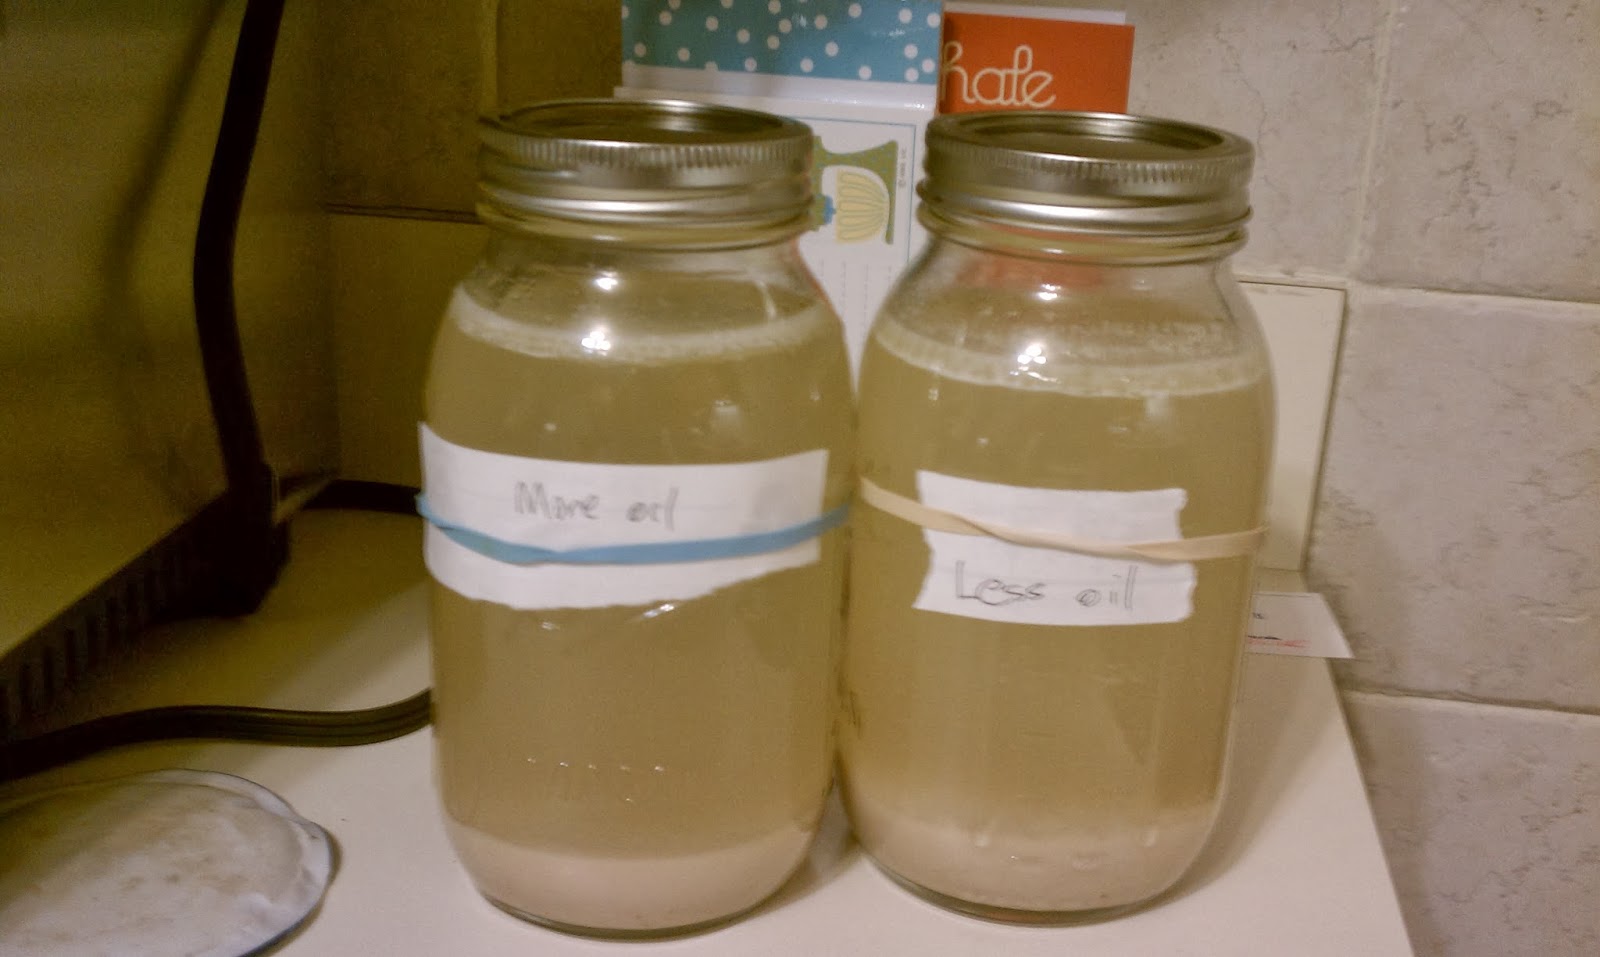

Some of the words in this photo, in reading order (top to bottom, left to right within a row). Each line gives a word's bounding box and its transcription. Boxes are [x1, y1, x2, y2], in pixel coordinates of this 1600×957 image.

[514, 481, 600, 520] More
[955, 560, 1047, 606] Less
[1076, 565, 1138, 612] oil
